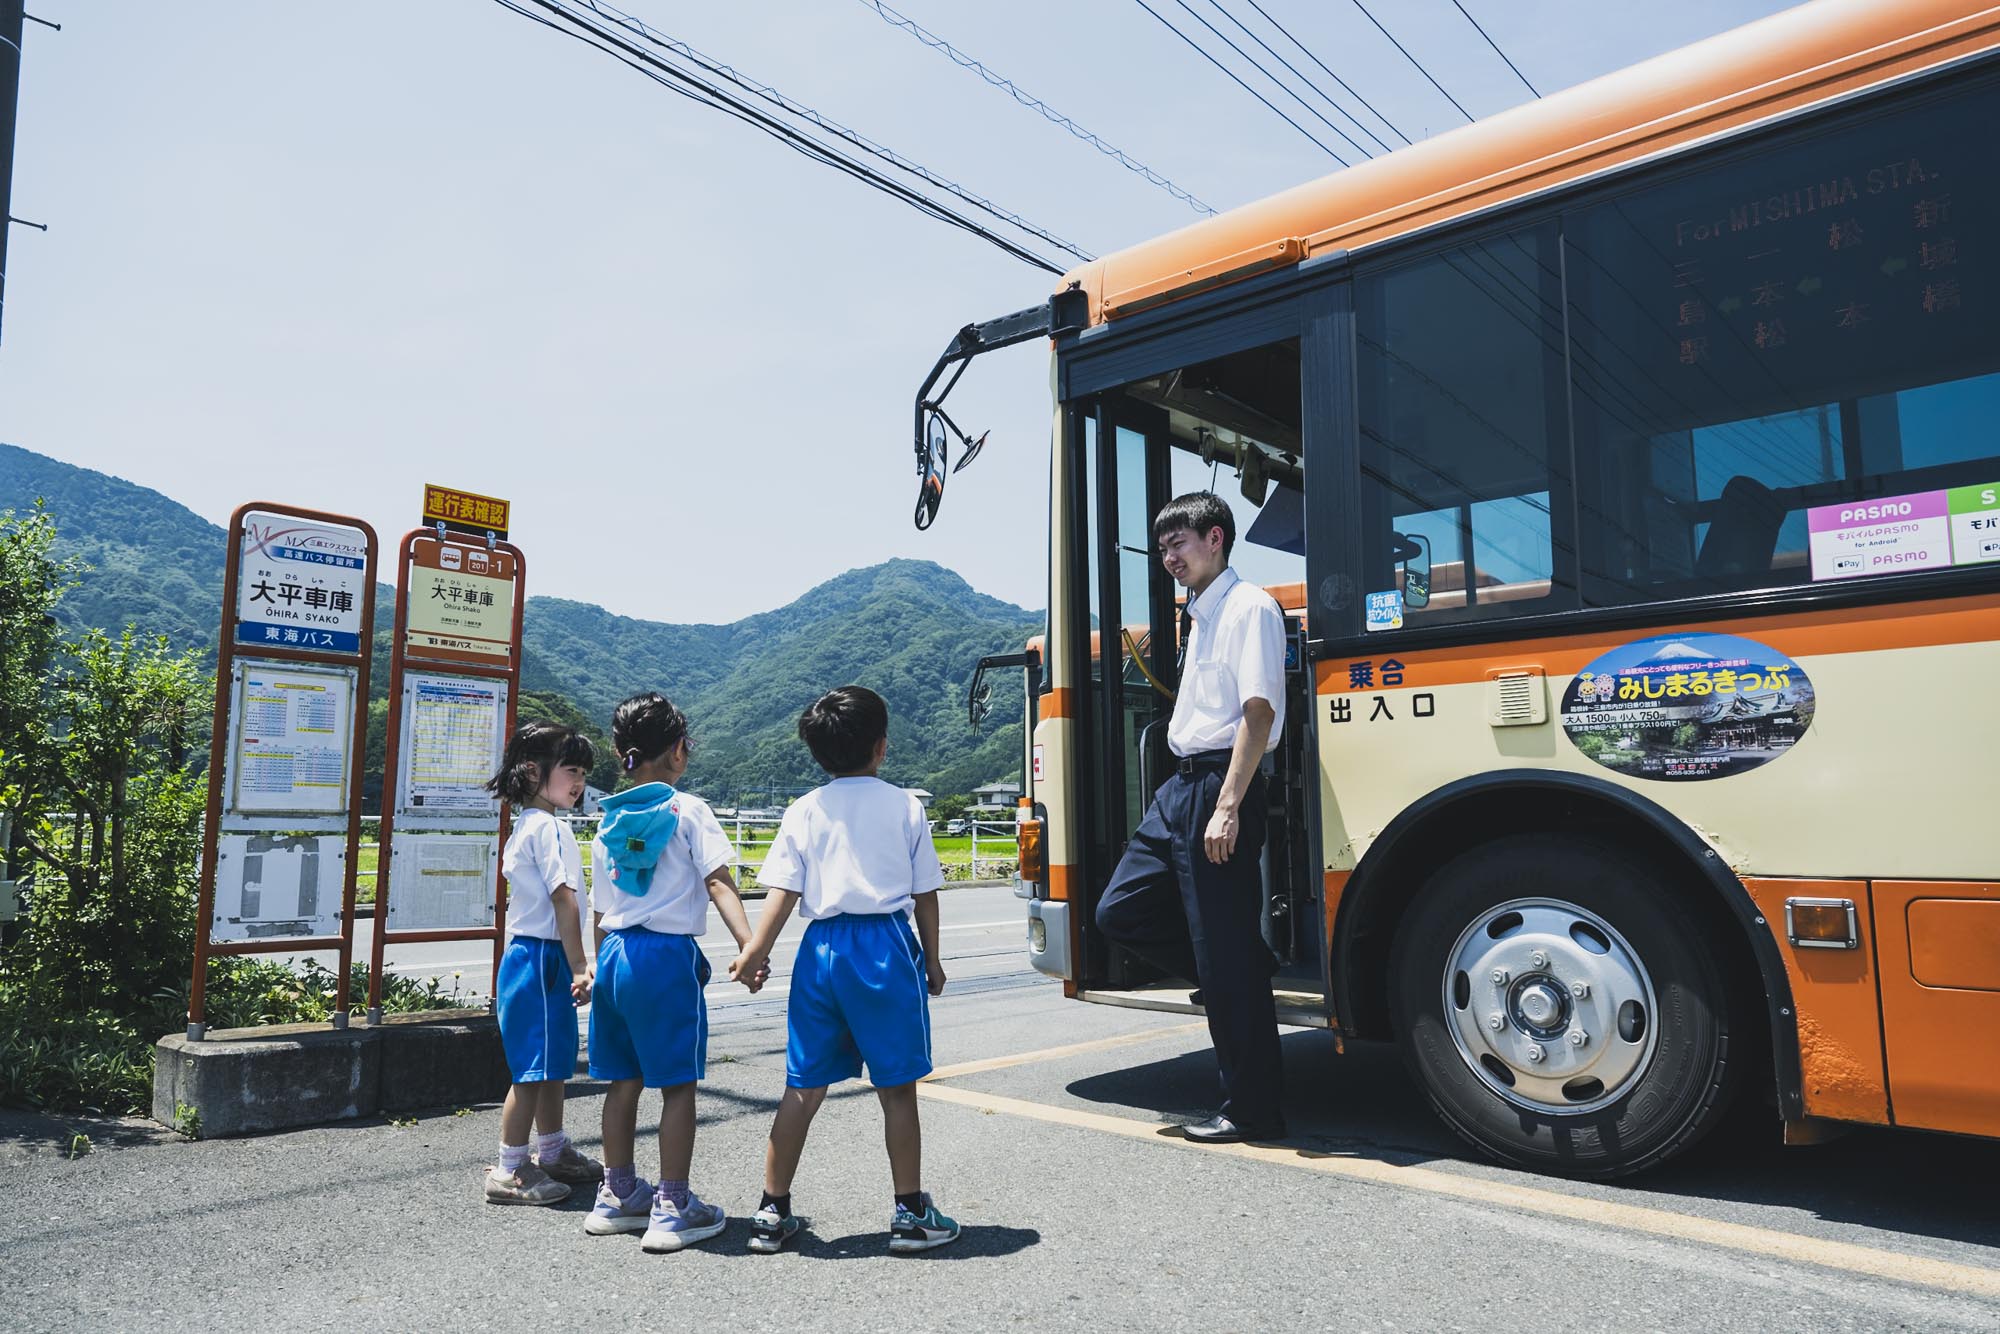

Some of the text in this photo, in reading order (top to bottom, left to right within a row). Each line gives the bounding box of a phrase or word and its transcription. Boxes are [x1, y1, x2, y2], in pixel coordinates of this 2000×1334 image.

[1729, 175, 1858, 232] MISHIMA
[428, 490, 505, 525] 運行表確認
[1840, 502, 1912, 523] PASMO
[283, 548, 356, 568] 高速バス停留所
[471, 562, 486, 571] 201
[1844, 550, 1928, 569] Pay PASMO
[257, 569, 272, 578] おお
[285, 573, 298, 581] ひら
[249, 579, 354, 613] 大平車庫
[431, 584, 495, 607] 大平車庫
[265, 606, 340, 625] ŌHIRA SYAKO
[265, 626, 335, 647] 東海バス
[1348, 658, 1406, 689] 乗合
[1618, 664, 1791, 701] みしまるきっぷ
[1330, 693, 1435, 723] 出入口
[1566, 716, 1583, 725] 大人
[1620, 713, 1637, 721] 小人
